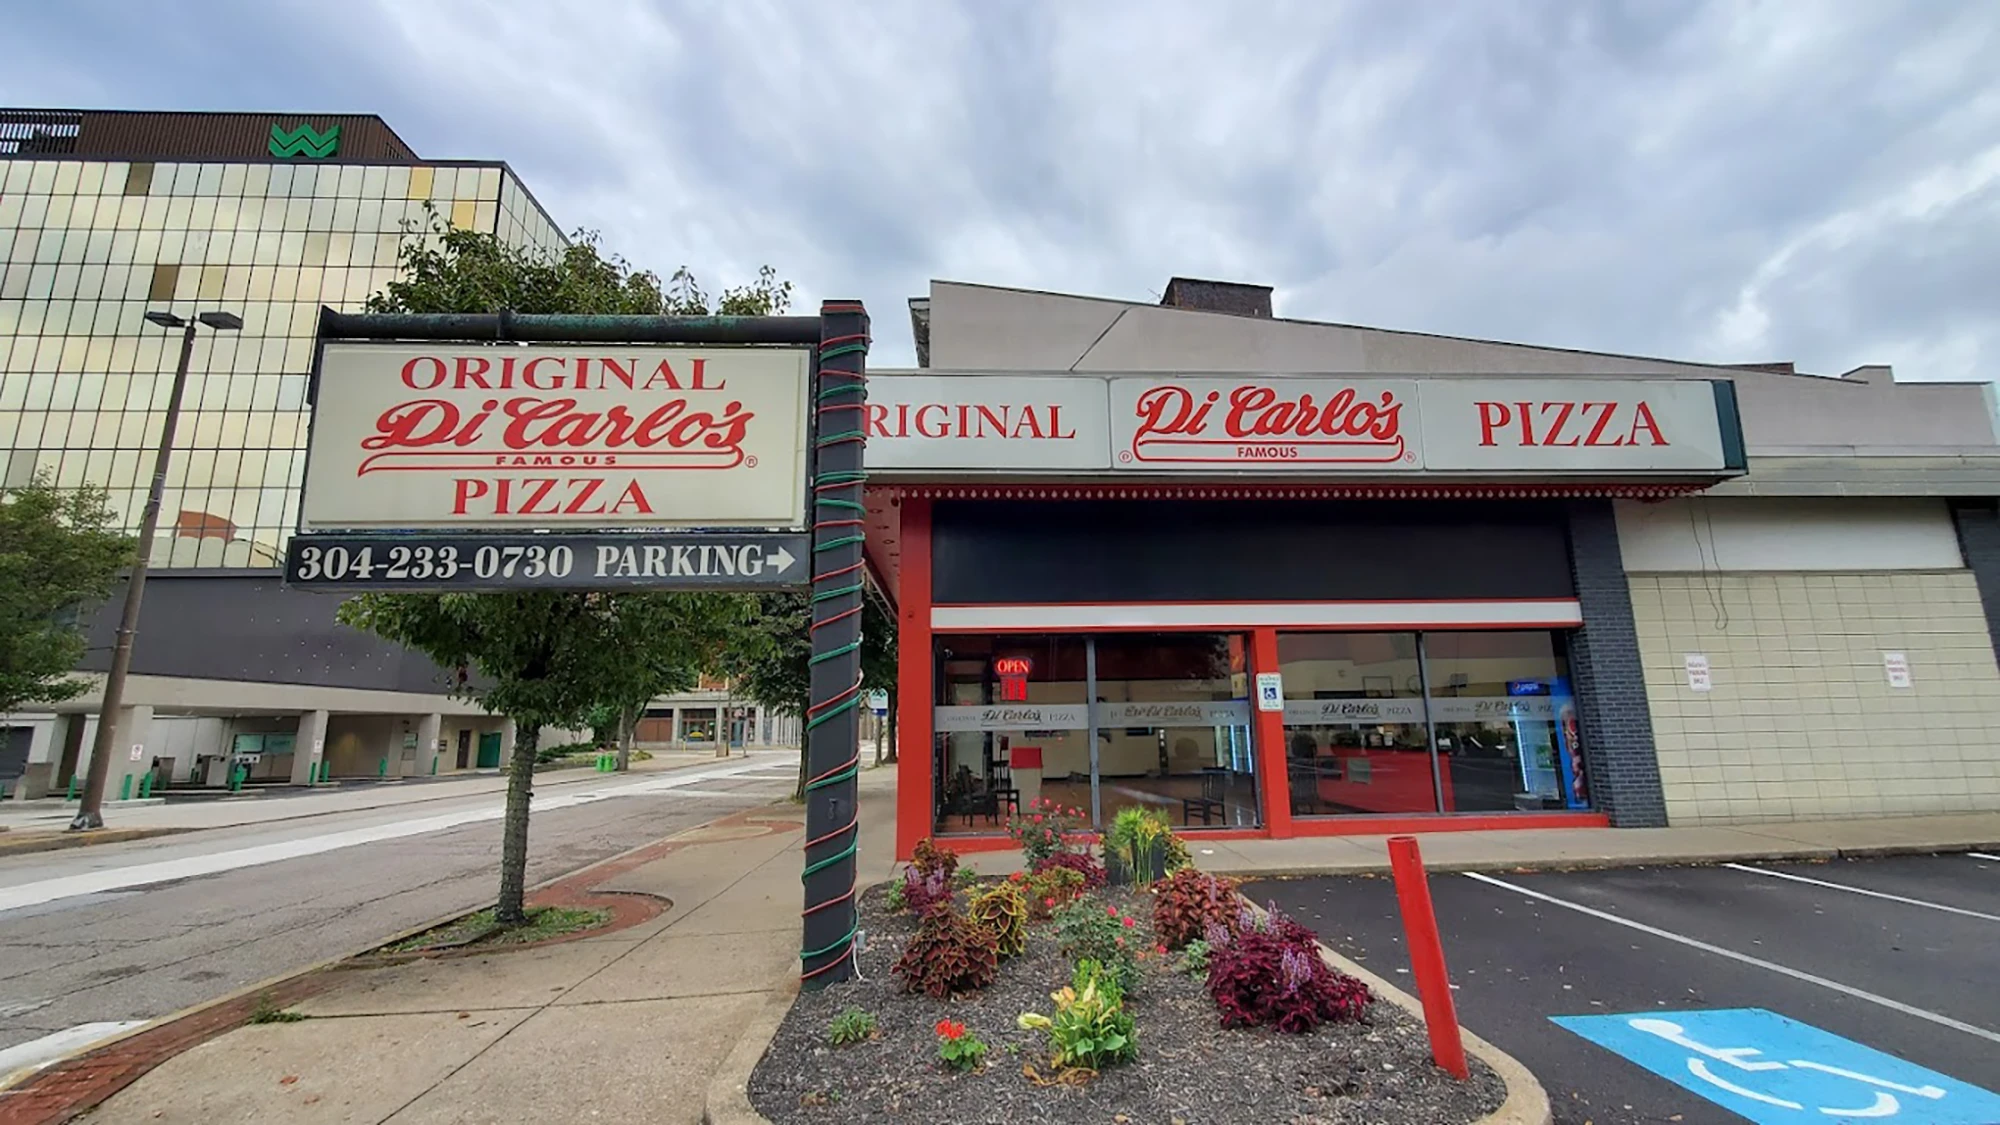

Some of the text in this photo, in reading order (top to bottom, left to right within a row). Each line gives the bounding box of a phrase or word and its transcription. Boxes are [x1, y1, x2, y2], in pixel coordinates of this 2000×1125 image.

[401, 356, 725, 391] ORIGINAL
[360, 396, 755, 450] Di Carlo's
[864, 403, 1077, 439] RIGINAL
[1135, 385, 1403, 441] Di Carlo's
[1478, 401, 1669, 447] PIZZA
[495, 455, 618, 466] FAMOUS
[1236, 446, 1298, 459] FAMOUS
[450, 478, 655, 516] PIZZA
[298, 545, 764, 580] 304-233-0730 PARKING
[997, 658, 1029, 674] OPEN
[1048, 713, 1076, 722] PIZZA
[1387, 706, 1413, 716] PIZZA
